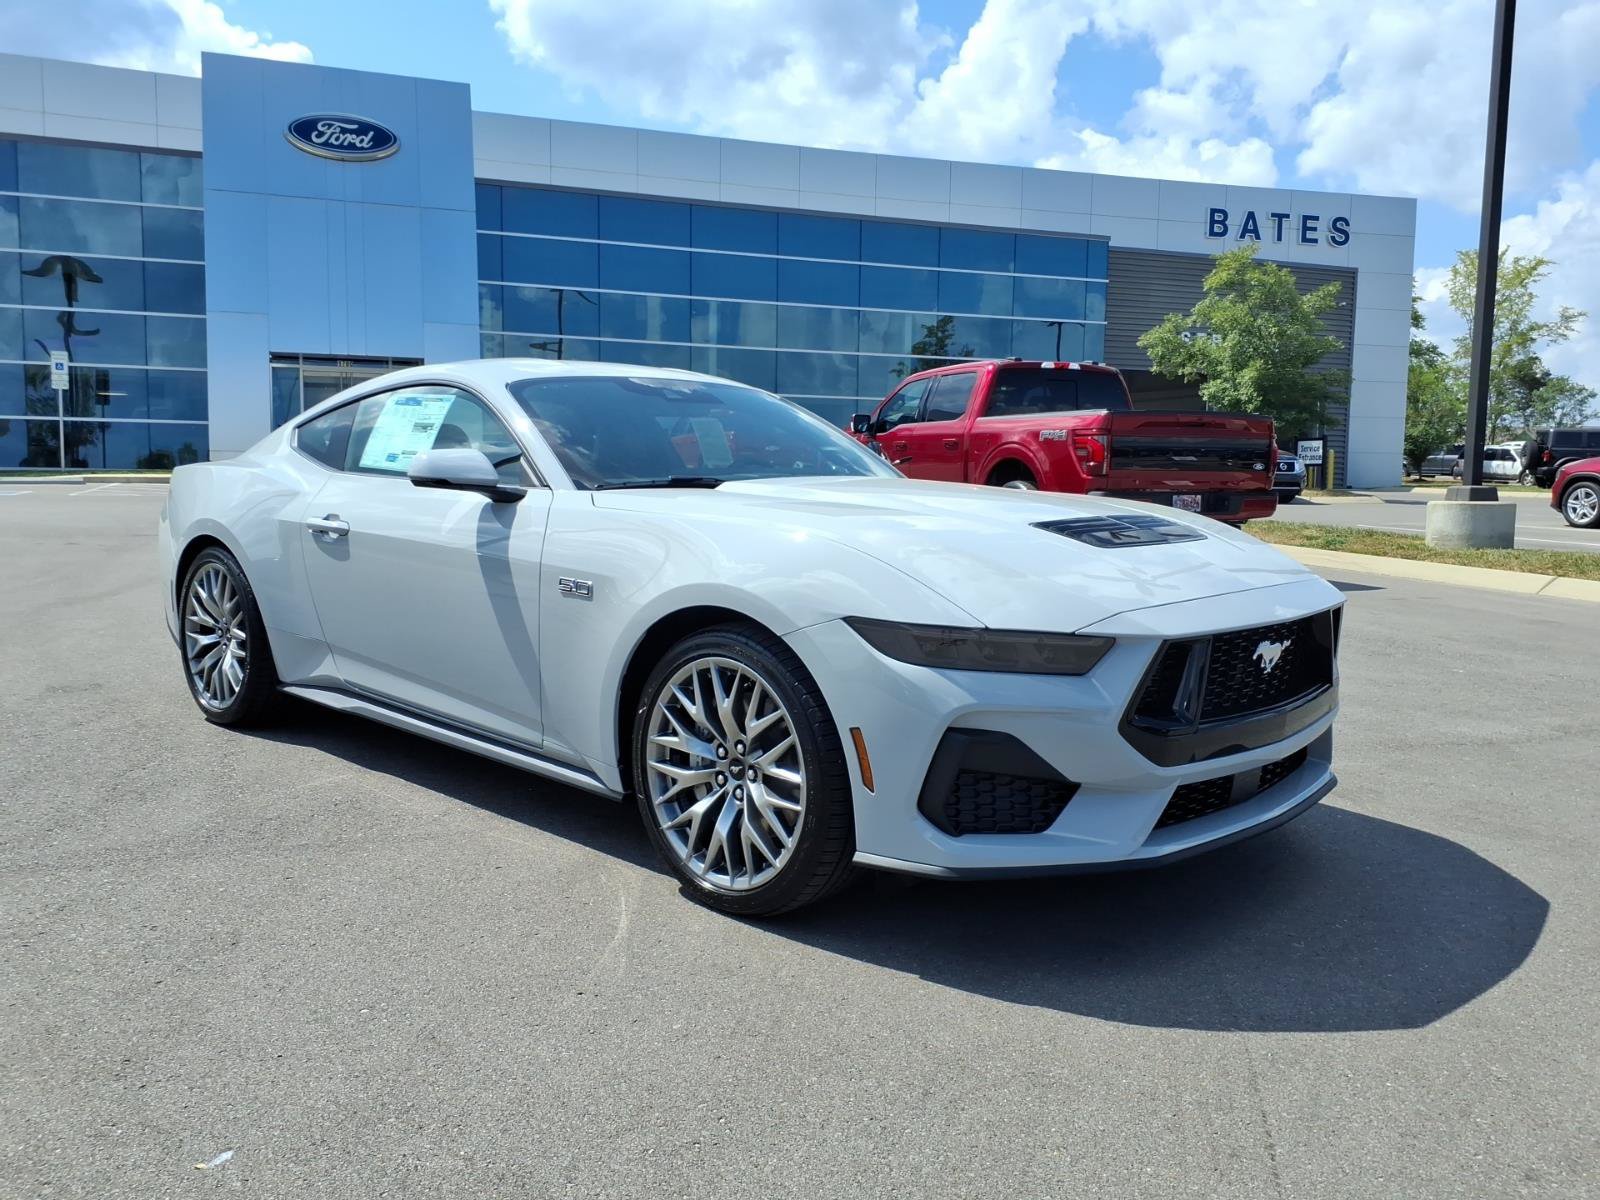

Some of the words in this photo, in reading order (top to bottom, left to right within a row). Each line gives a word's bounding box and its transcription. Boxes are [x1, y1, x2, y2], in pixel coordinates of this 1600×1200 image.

[311, 120, 374, 148] Ford
[1208, 207, 1351, 247] BATES
[1298, 453, 1322, 461] Entrance
